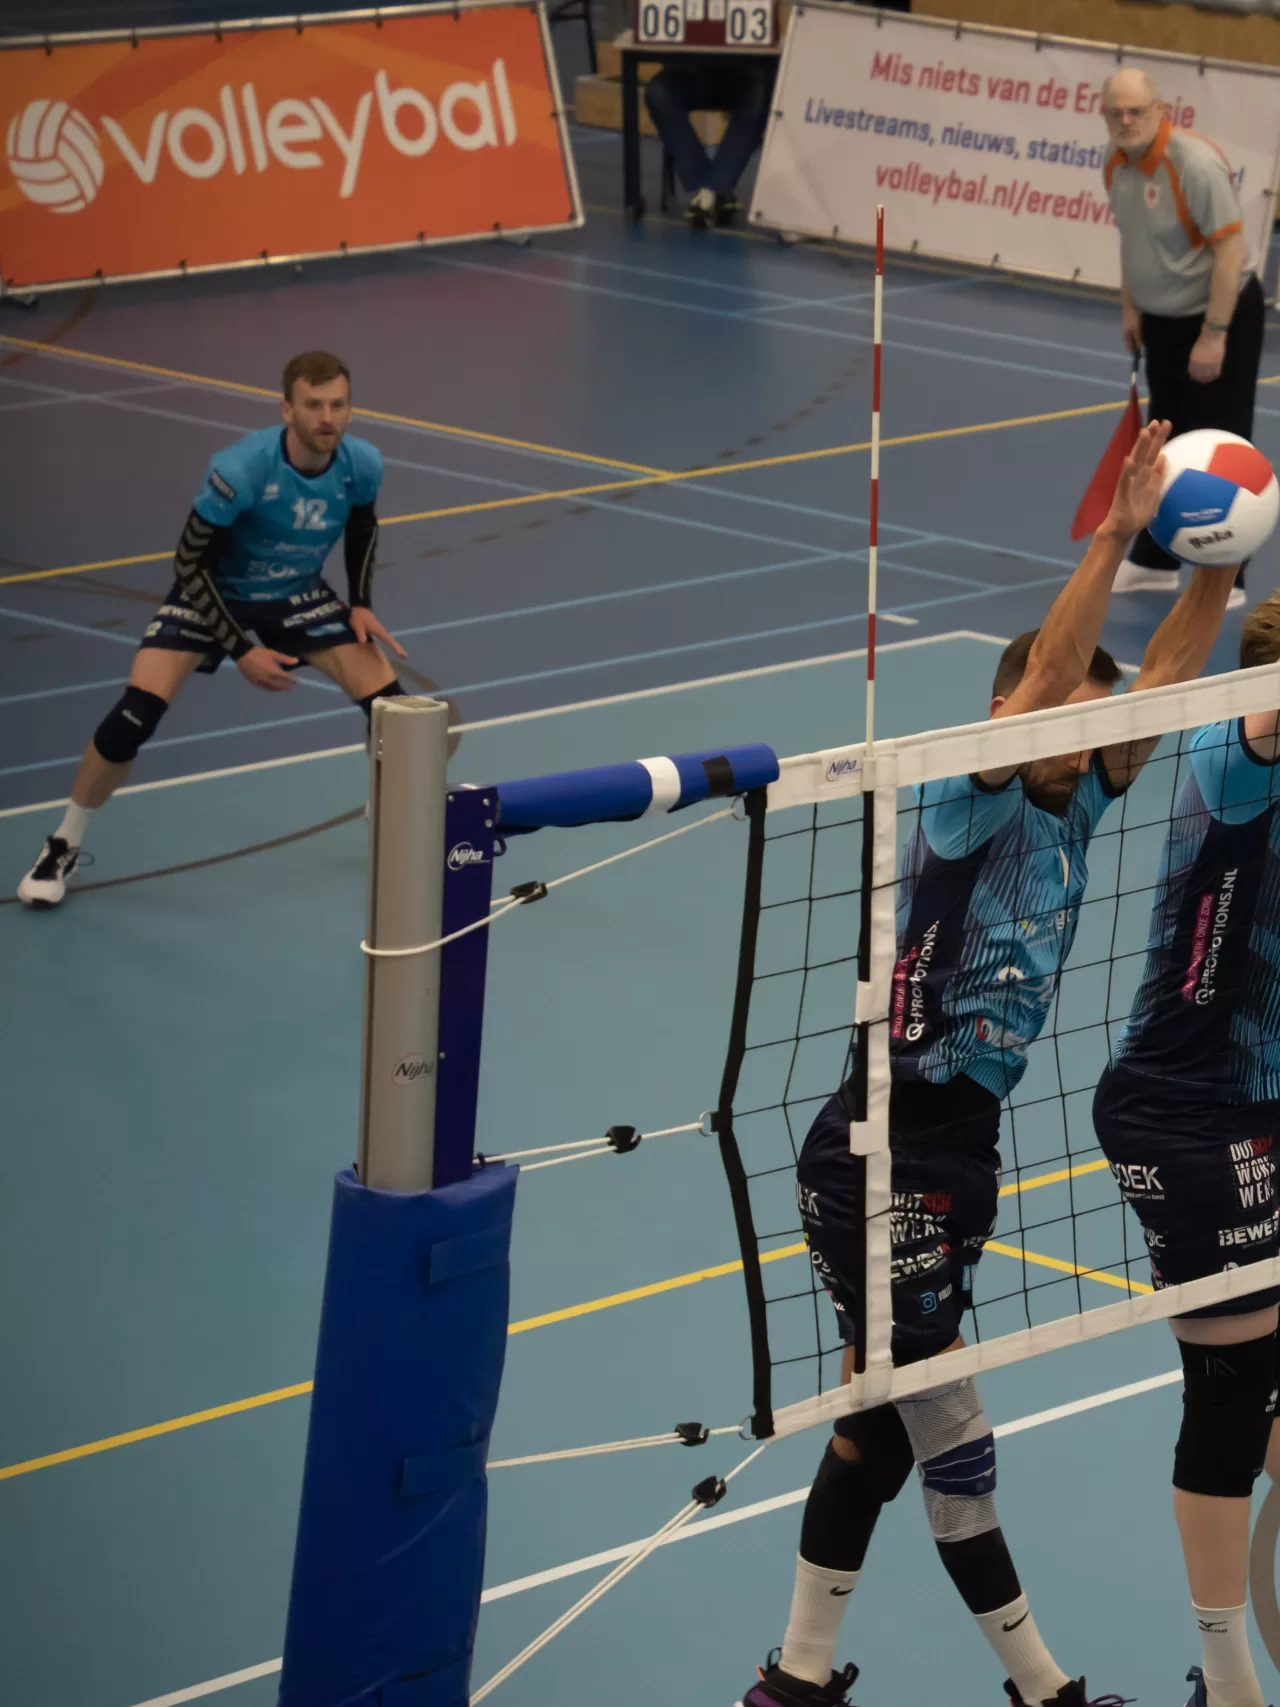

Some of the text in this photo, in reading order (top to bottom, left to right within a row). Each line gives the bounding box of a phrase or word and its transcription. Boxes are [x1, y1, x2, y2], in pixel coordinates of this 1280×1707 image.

[643, 4, 679, 37] 06
[730, 7, 767, 41] 03
[871, 51, 912, 85] Mis
[918, 65, 980, 97] niets
[986, 77, 1029, 103] van
[1036, 79, 1068, 109] de
[100, 59, 518, 199] volleybal
[804, 97, 935, 146] Livestreams,
[941, 122, 1020, 159] nieuws,
[292, 496, 328, 530] 12
